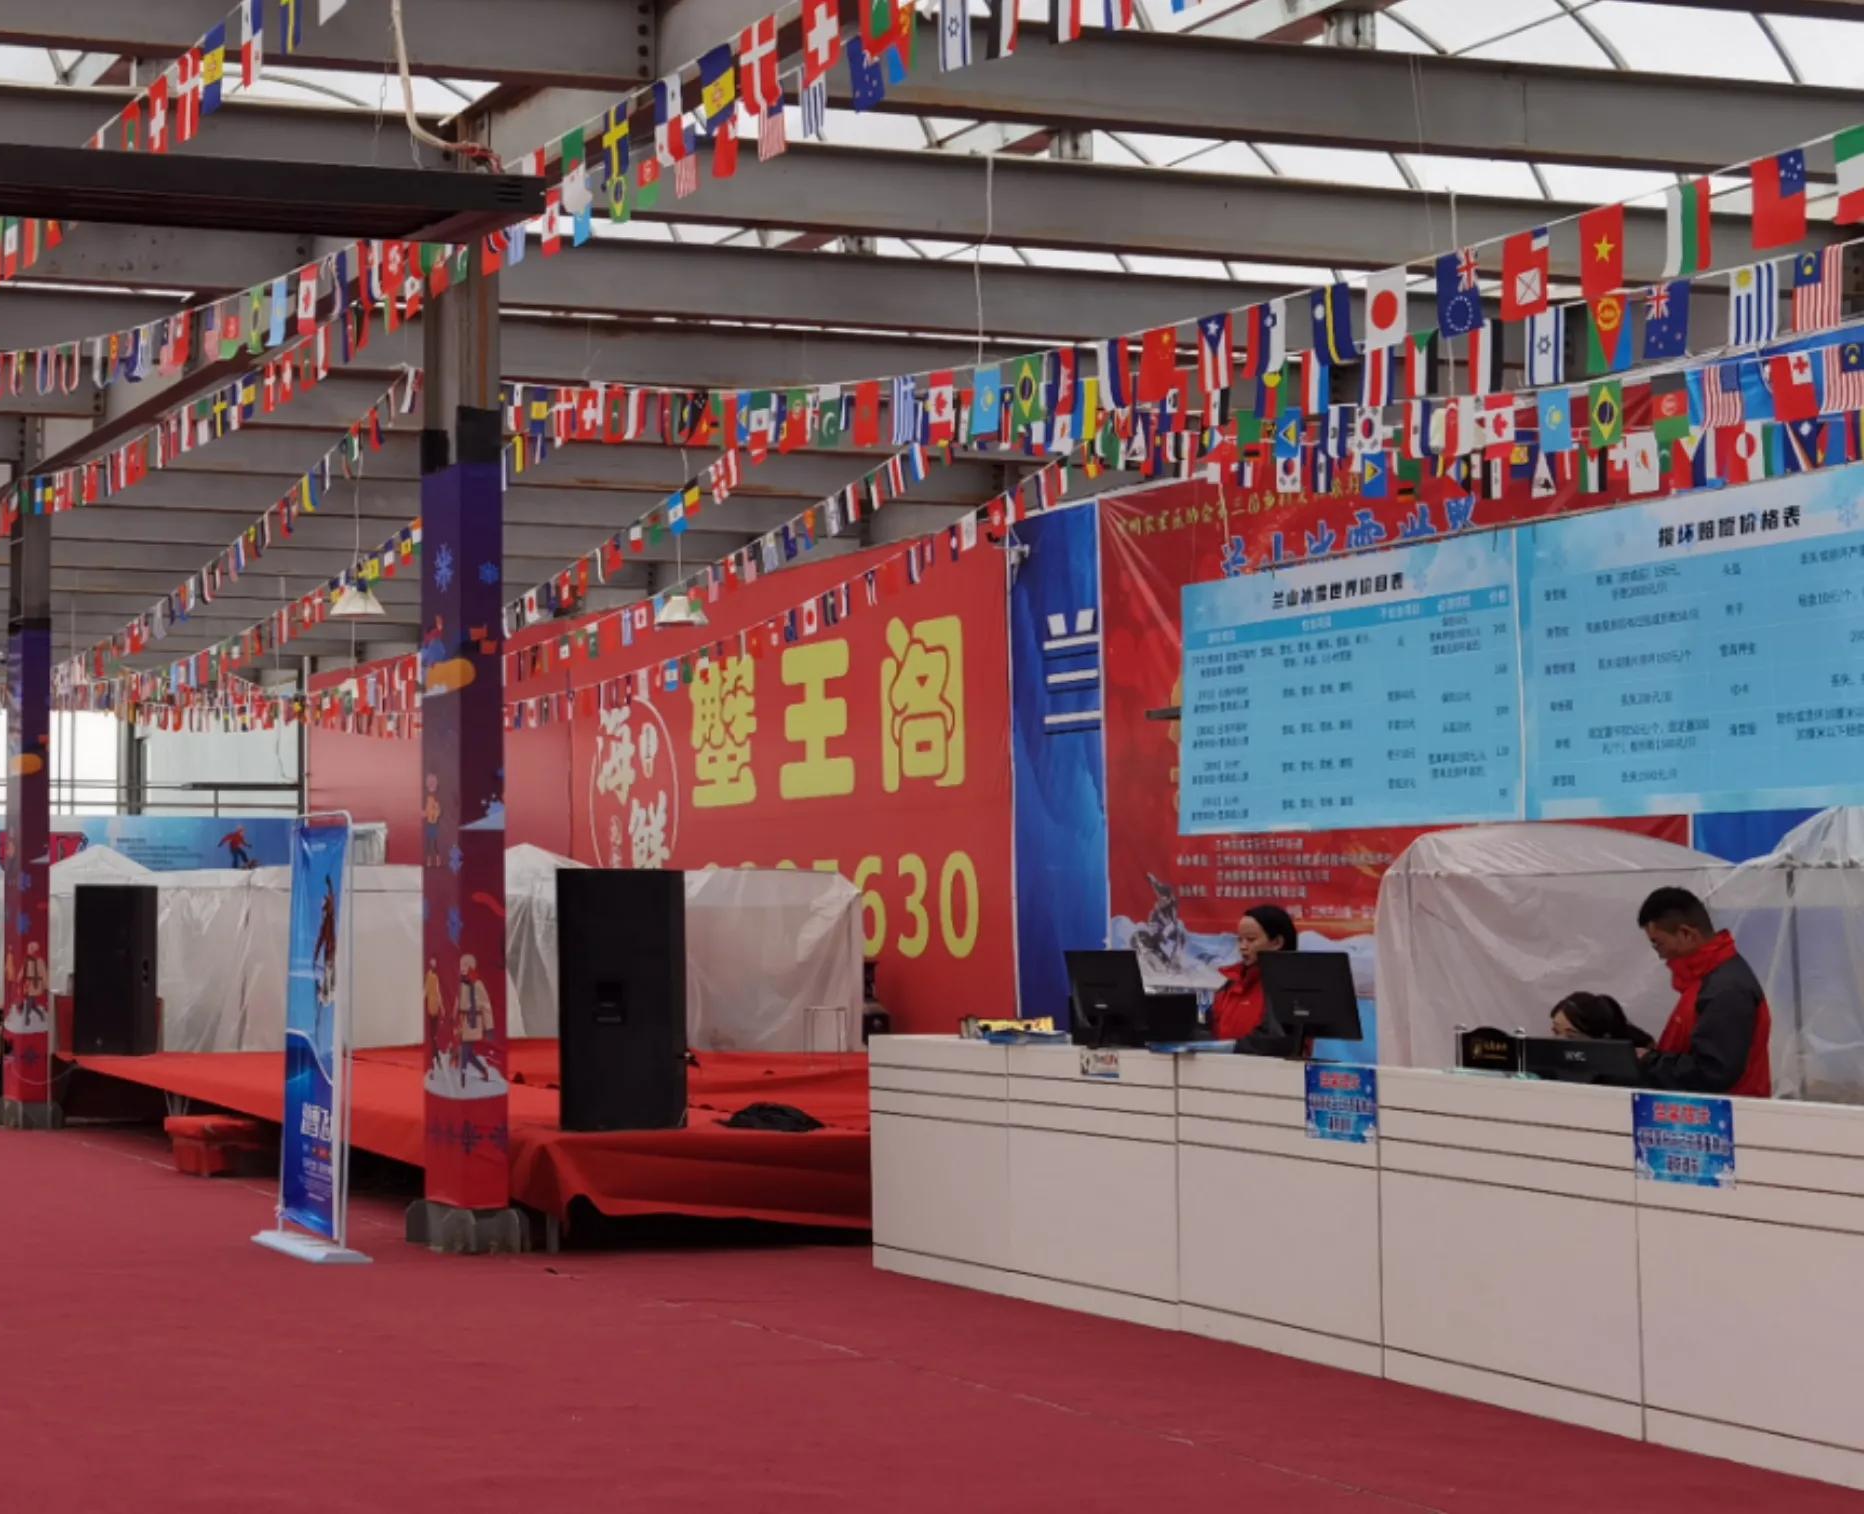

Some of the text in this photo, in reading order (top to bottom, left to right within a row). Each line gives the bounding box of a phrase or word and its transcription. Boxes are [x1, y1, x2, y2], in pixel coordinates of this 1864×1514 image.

[1658, 505, 1801, 548] 损坏赔偿价格表
[690, 615, 966, 808] 蟹王阁
